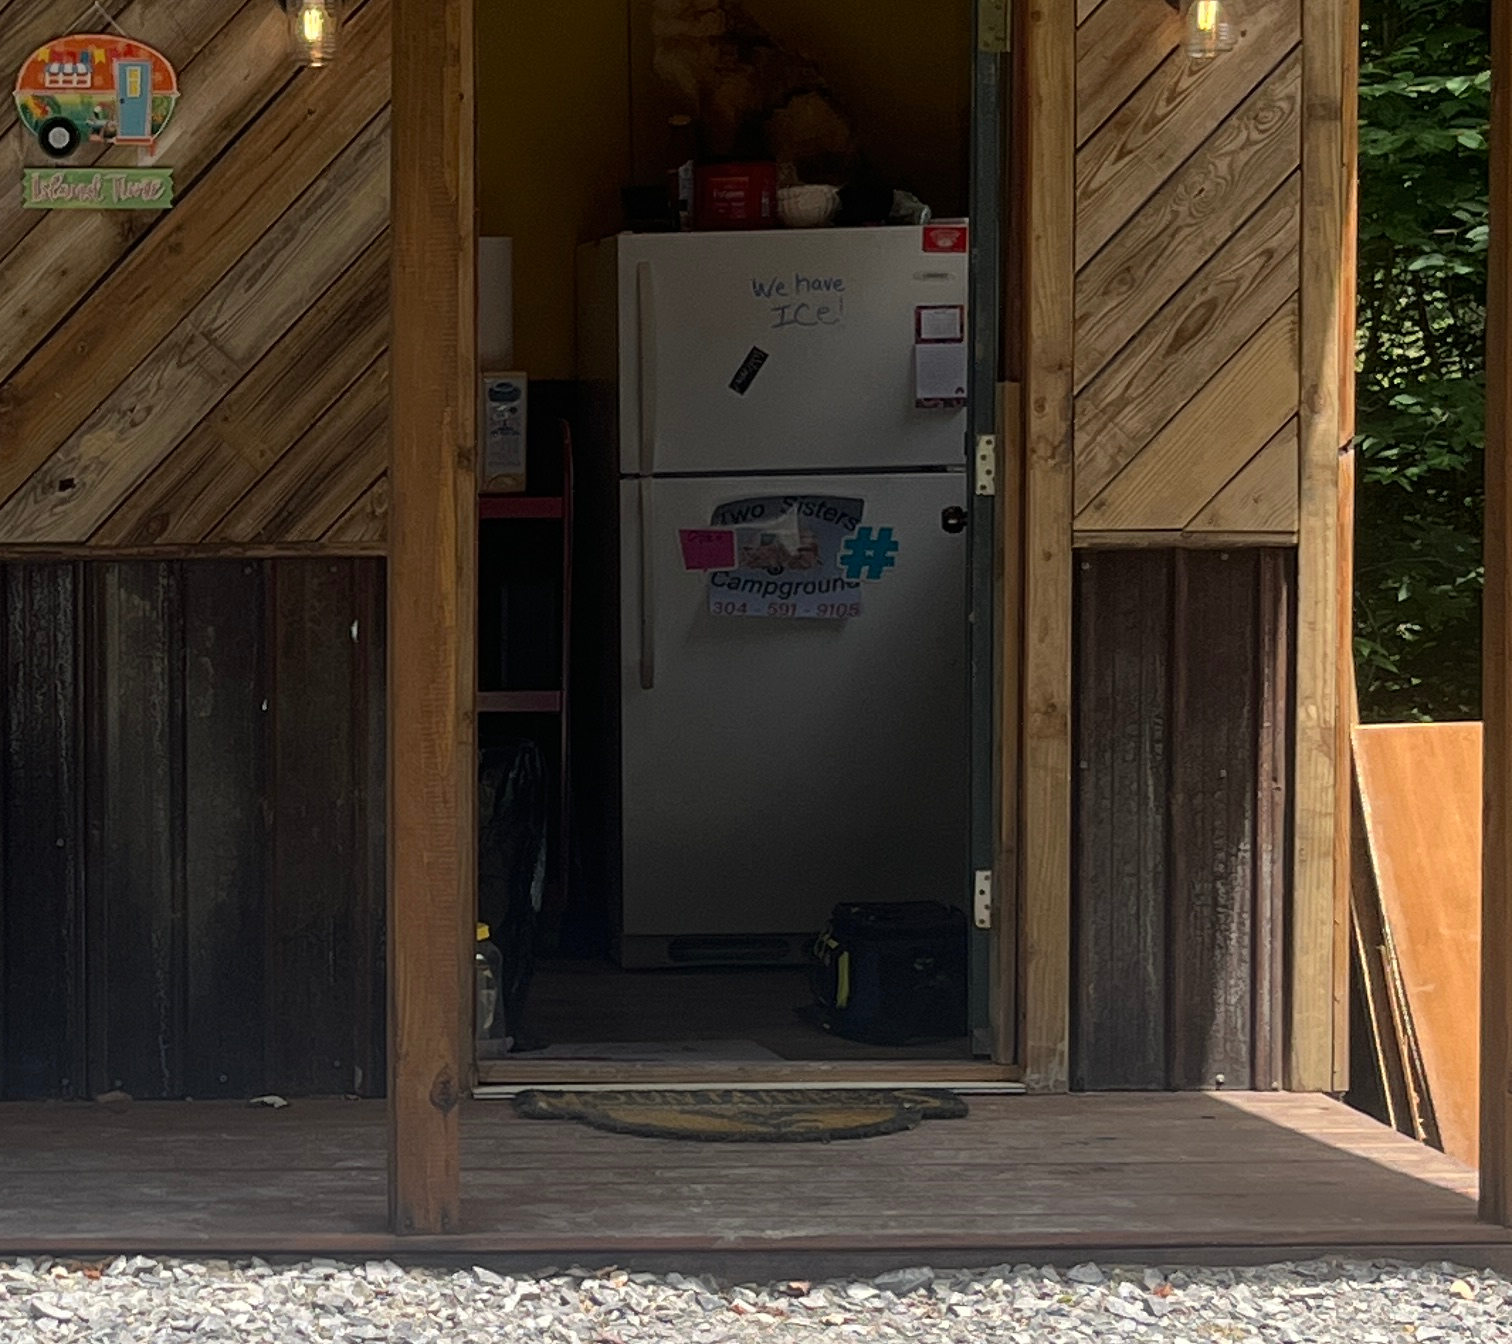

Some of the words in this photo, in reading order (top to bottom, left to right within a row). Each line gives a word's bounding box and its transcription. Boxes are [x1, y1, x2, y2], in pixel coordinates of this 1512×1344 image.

[31, 172, 104, 202] Island
[752, 276, 789, 298] We
[795, 272, 845, 294] have
[720, 503, 765, 524] Two
[780, 495, 862, 532] Sisters
